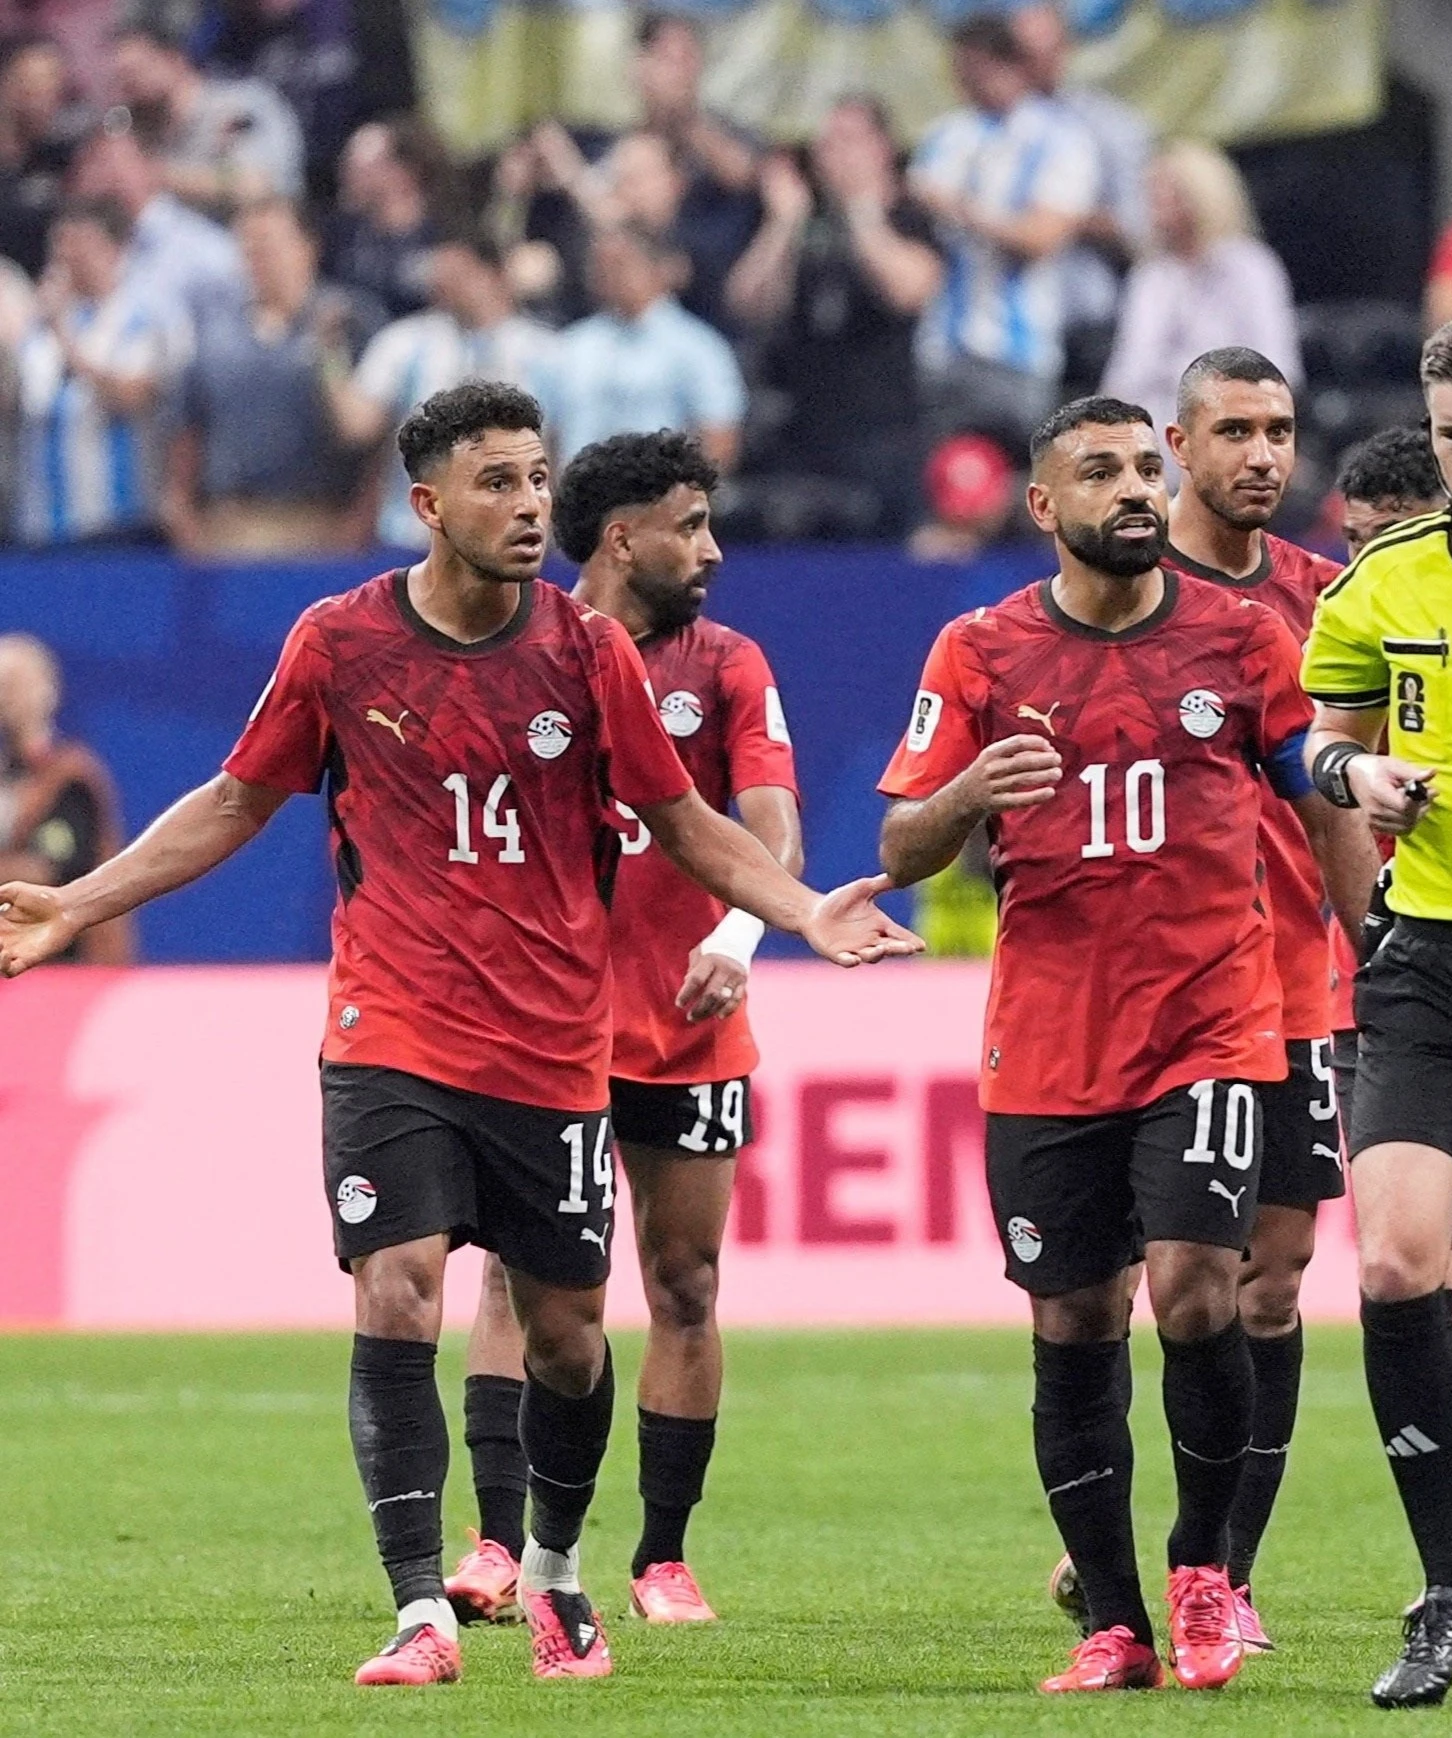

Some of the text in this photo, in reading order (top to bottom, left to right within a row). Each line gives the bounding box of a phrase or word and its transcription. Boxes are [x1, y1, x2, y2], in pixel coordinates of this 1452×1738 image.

[443, 773, 525, 863] 14
[1078, 759, 1166, 859] 10
[678, 1080, 744, 1151] 19
[1183, 1078, 1255, 1170] 10
[1309, 1037, 1337, 1121] 5
[558, 1116, 614, 1213] 14
